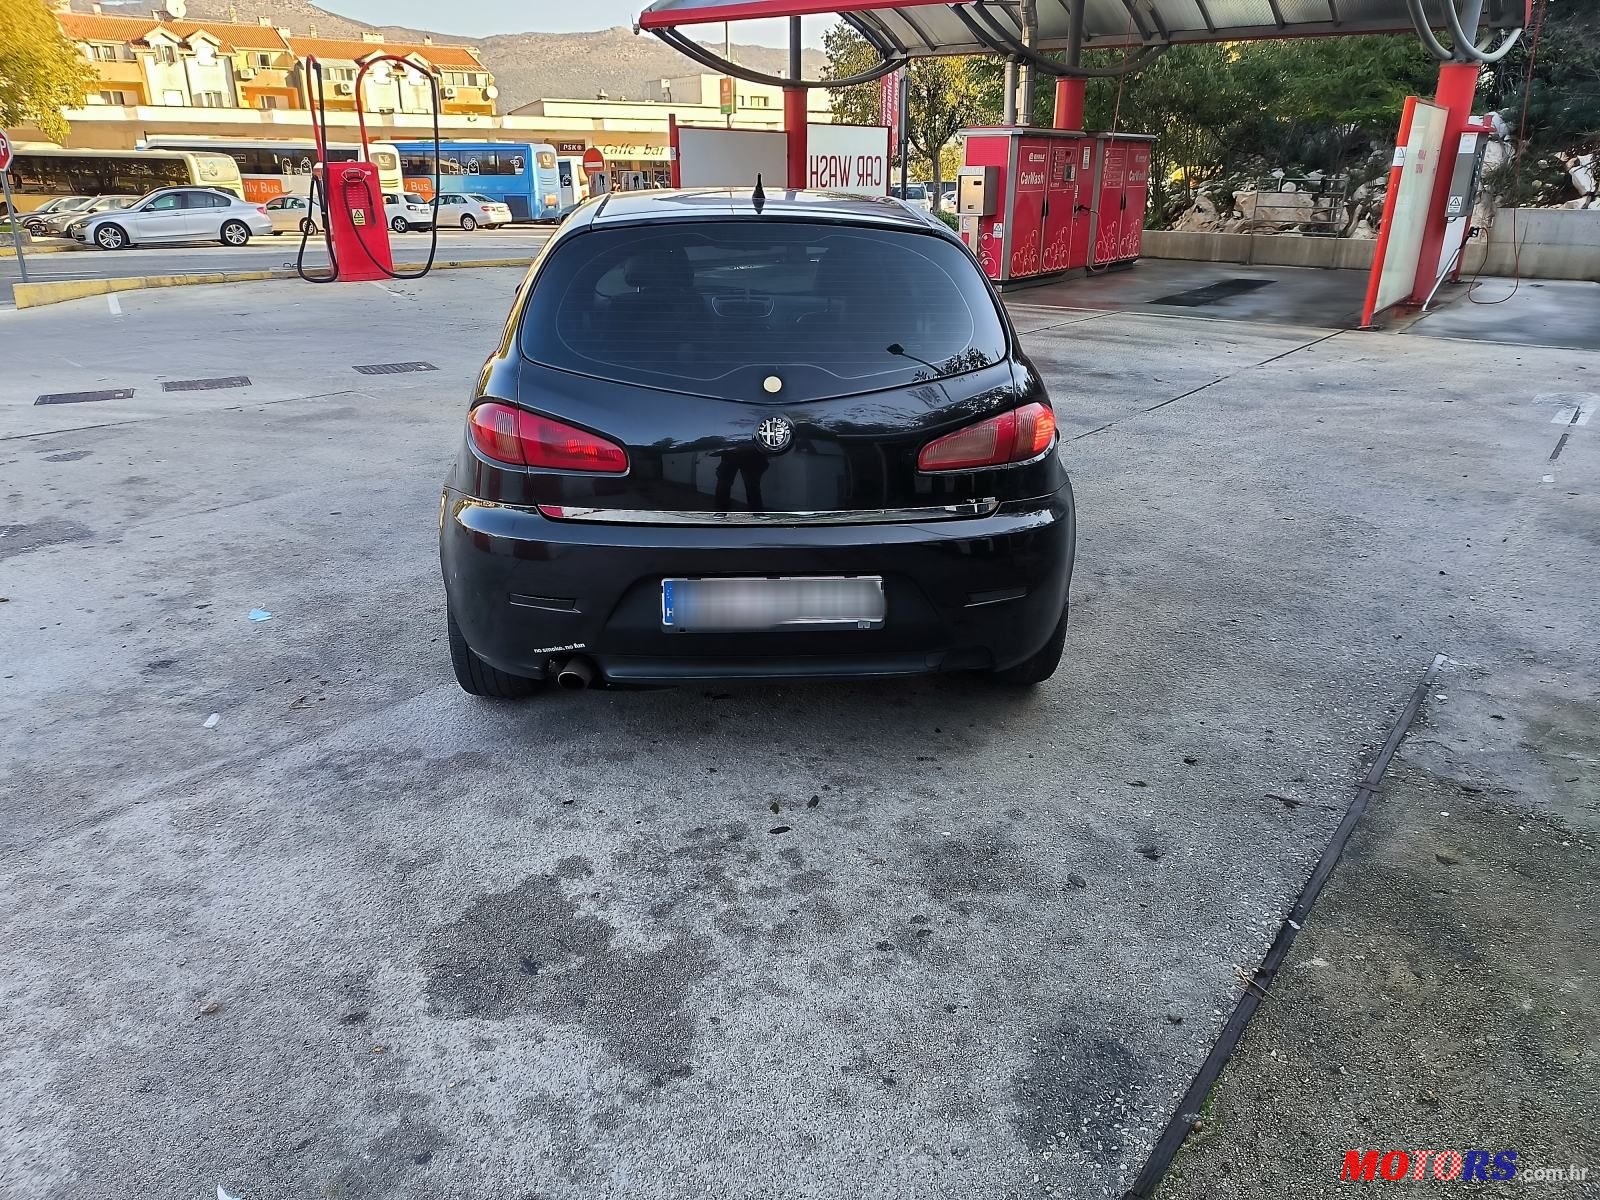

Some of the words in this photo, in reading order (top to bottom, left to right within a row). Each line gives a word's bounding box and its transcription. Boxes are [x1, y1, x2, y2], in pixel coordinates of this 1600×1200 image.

[1020, 171, 1045, 185] CarWash
[260, 181, 280, 193] Bus
[410, 181, 429, 192] Bus
